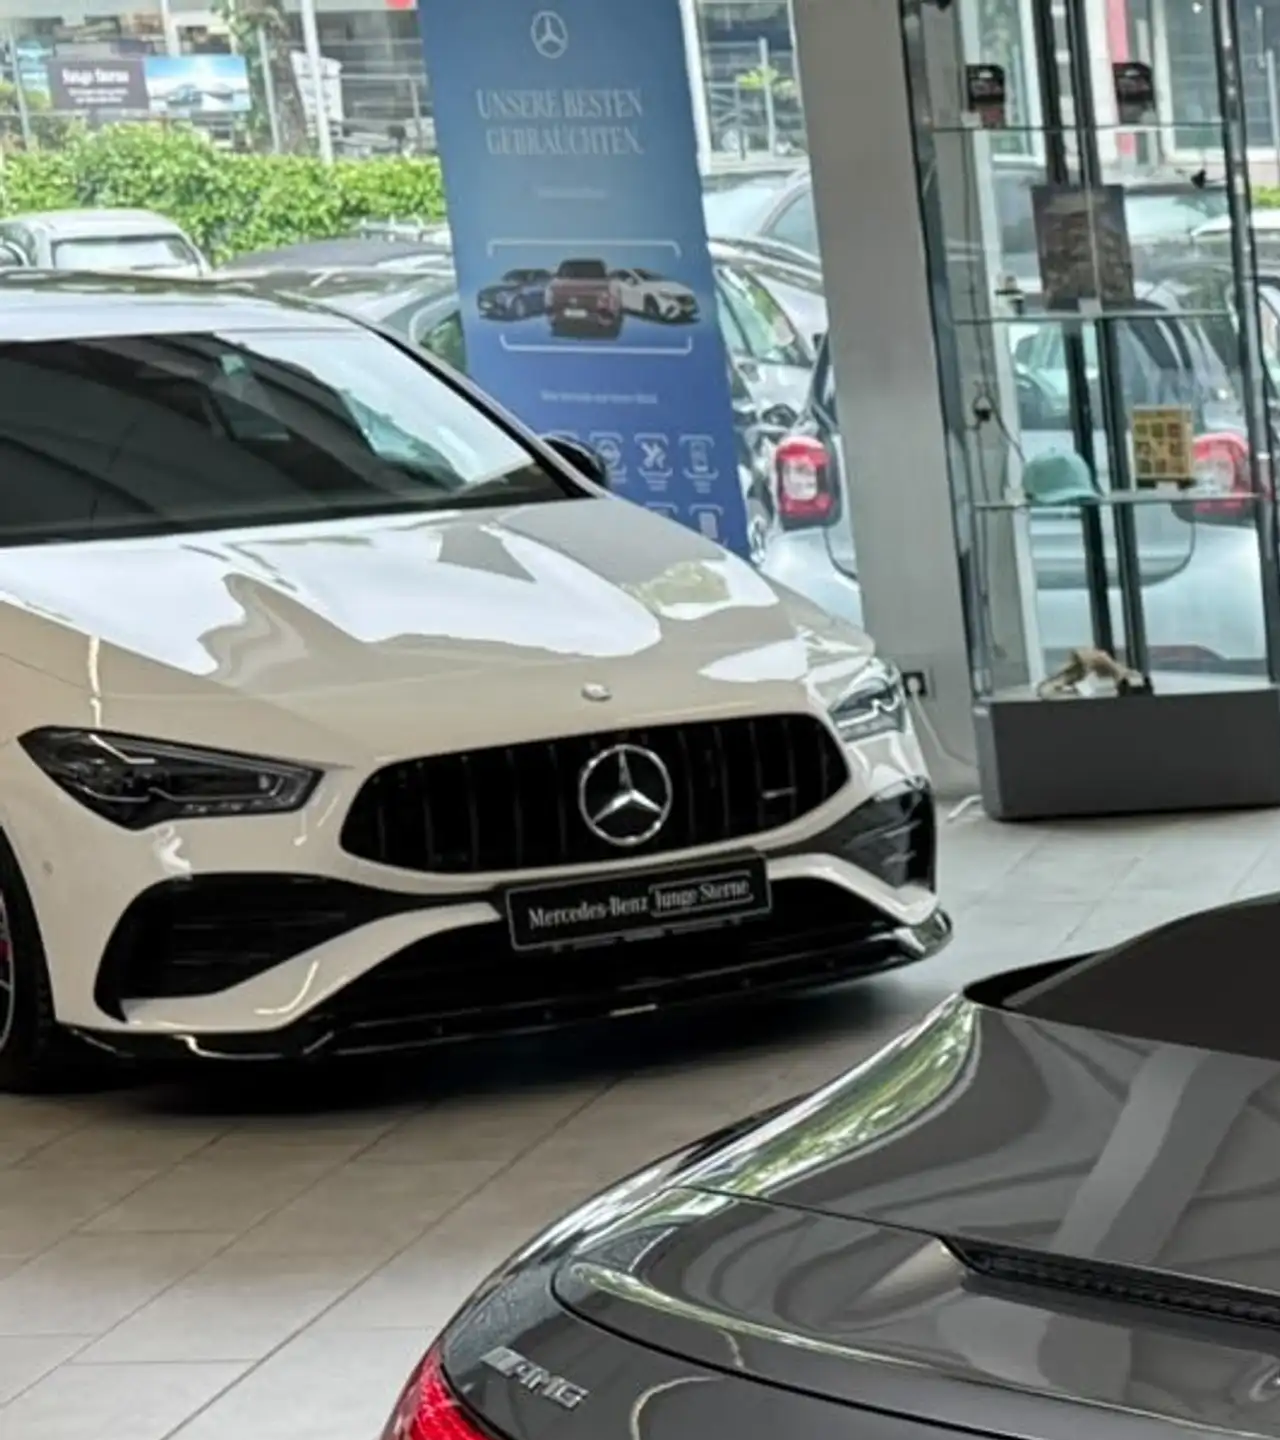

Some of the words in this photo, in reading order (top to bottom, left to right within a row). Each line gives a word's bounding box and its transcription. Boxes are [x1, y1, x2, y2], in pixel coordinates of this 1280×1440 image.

[529, 895, 648, 930] Mercedes-Benz
[655, 886, 698, 910] Junge
[699, 879, 750, 900] Sterne
